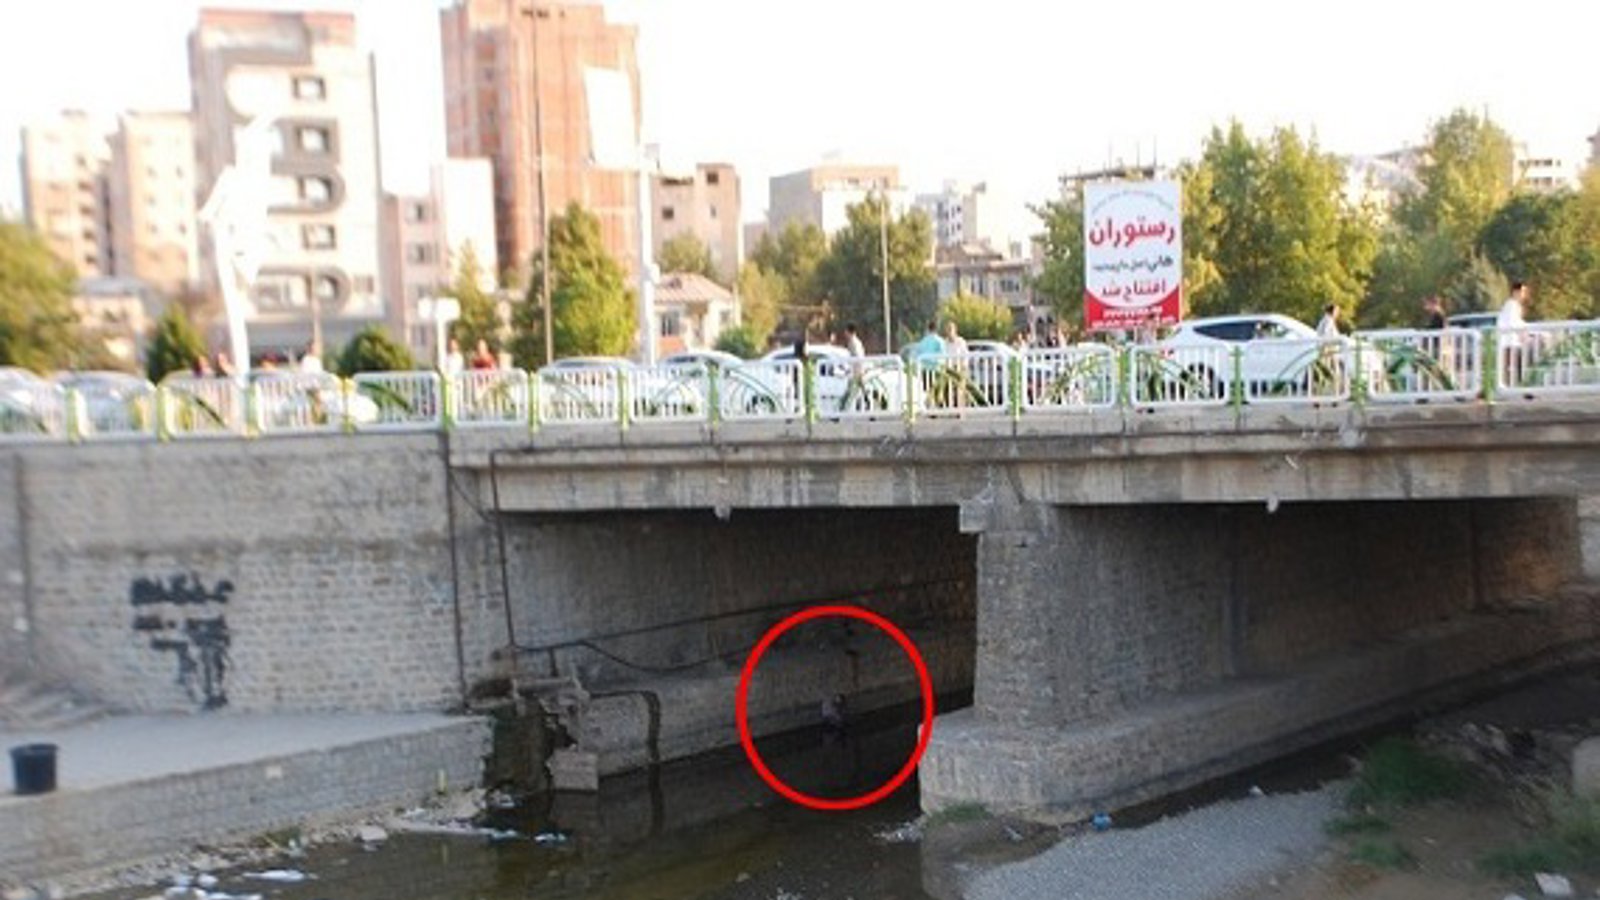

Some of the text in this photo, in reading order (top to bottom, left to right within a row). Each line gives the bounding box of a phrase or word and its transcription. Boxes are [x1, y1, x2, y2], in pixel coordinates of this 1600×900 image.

[1089, 215, 1175, 247] رستوران
[1102, 279, 1166, 302] افتتاح شد
